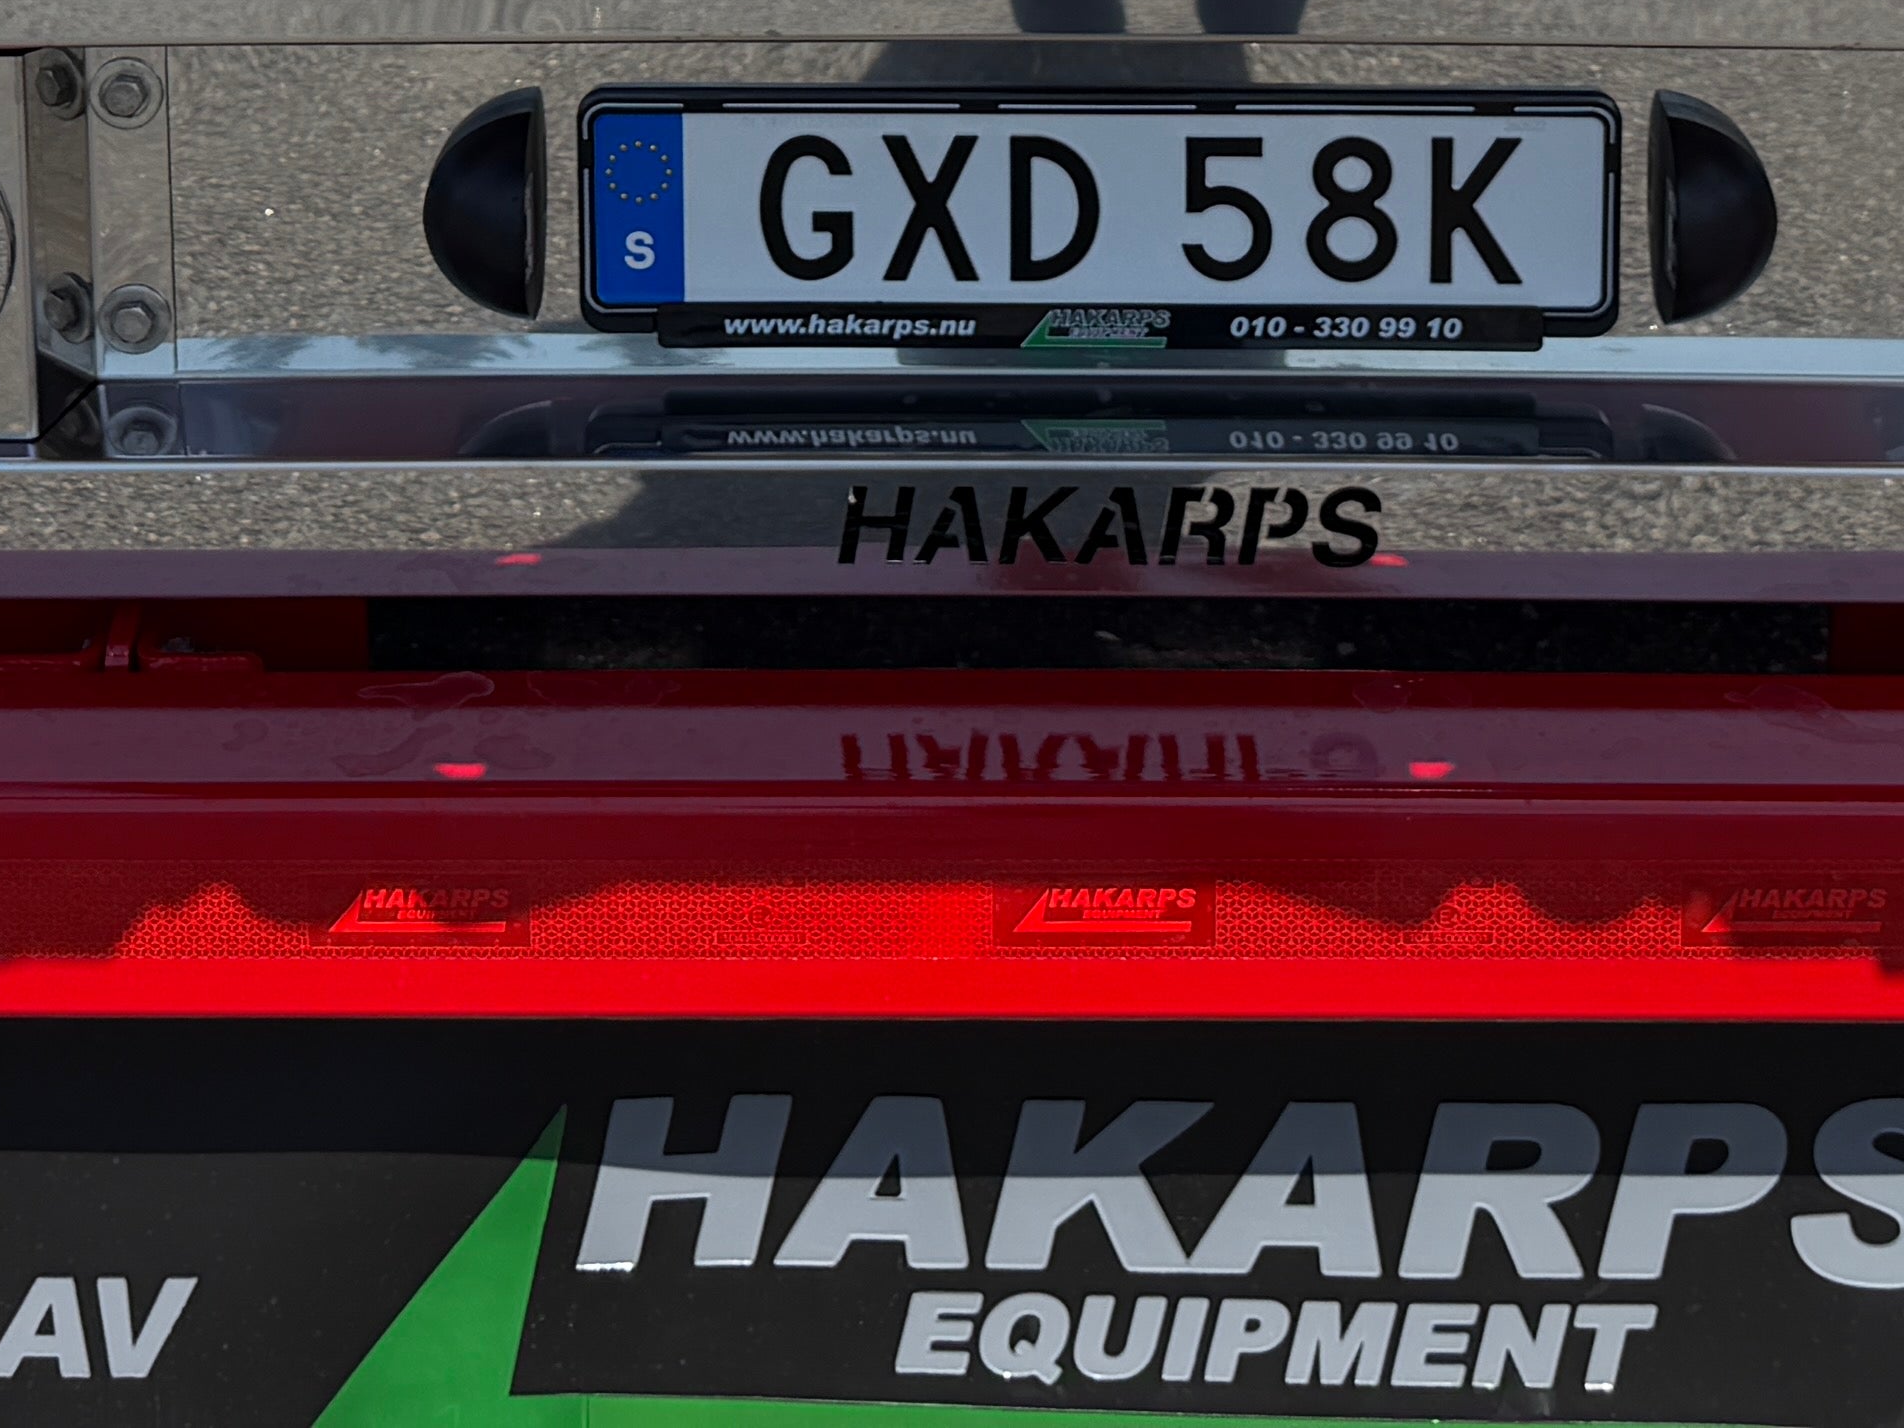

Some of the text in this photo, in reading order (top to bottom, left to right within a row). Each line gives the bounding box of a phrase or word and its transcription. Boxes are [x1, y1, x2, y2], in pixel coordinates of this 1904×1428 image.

[758, 134, 1524, 285] GXD 58K
[624, 230, 656, 271] S
[724, 312, 976, 340] www.hakarps.nu
[1049, 309, 1171, 328] HAKARPS
[1229, 316, 1286, 339] 010
[1313, 316, 1367, 339] 330
[1375, 316, 1412, 340] 99
[1421, 317, 1462, 340] 10
[838, 485, 1382, 567] HAKARPS
[364, 888, 510, 909] HAKARPS
[1048, 888, 1197, 909] HAKARPS
[1739, 888, 1888, 909] HAKARPS
[1082, 909, 1164, 920] EQUIPMENT
[894, 1289, 1657, 1392] EQUIPMENT
